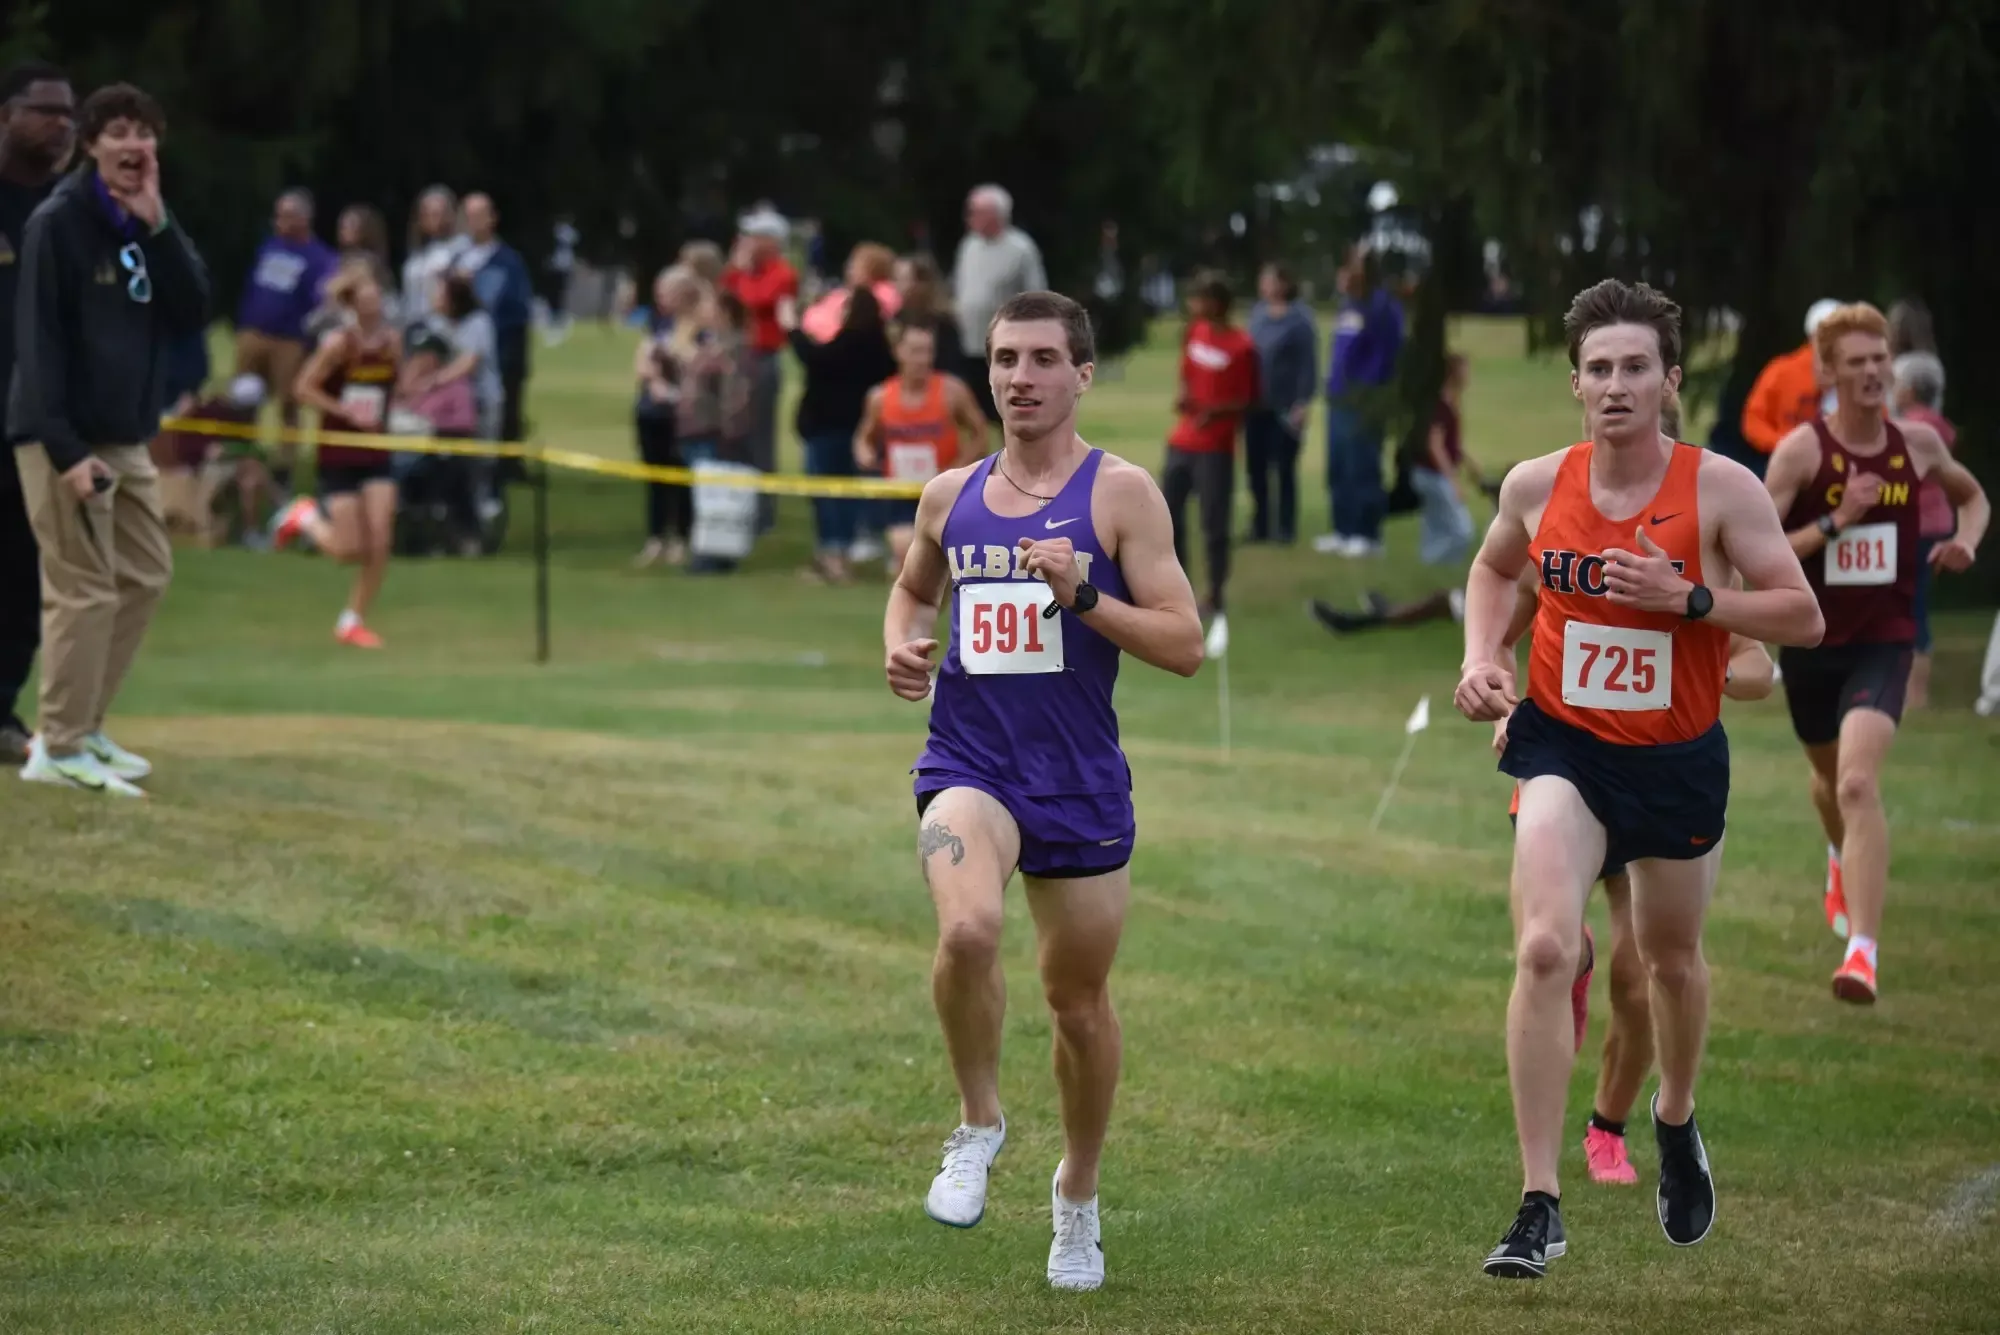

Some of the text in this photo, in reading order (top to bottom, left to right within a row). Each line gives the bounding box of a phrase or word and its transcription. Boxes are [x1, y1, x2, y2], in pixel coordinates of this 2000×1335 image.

[1825, 481, 1909, 506] CIN
[947, 544, 1093, 583] ALBIN
[1541, 550, 1684, 597] HO
[1837, 537, 1886, 572] 681
[972, 603, 1044, 654] 591
[1577, 642, 1656, 693] 725
